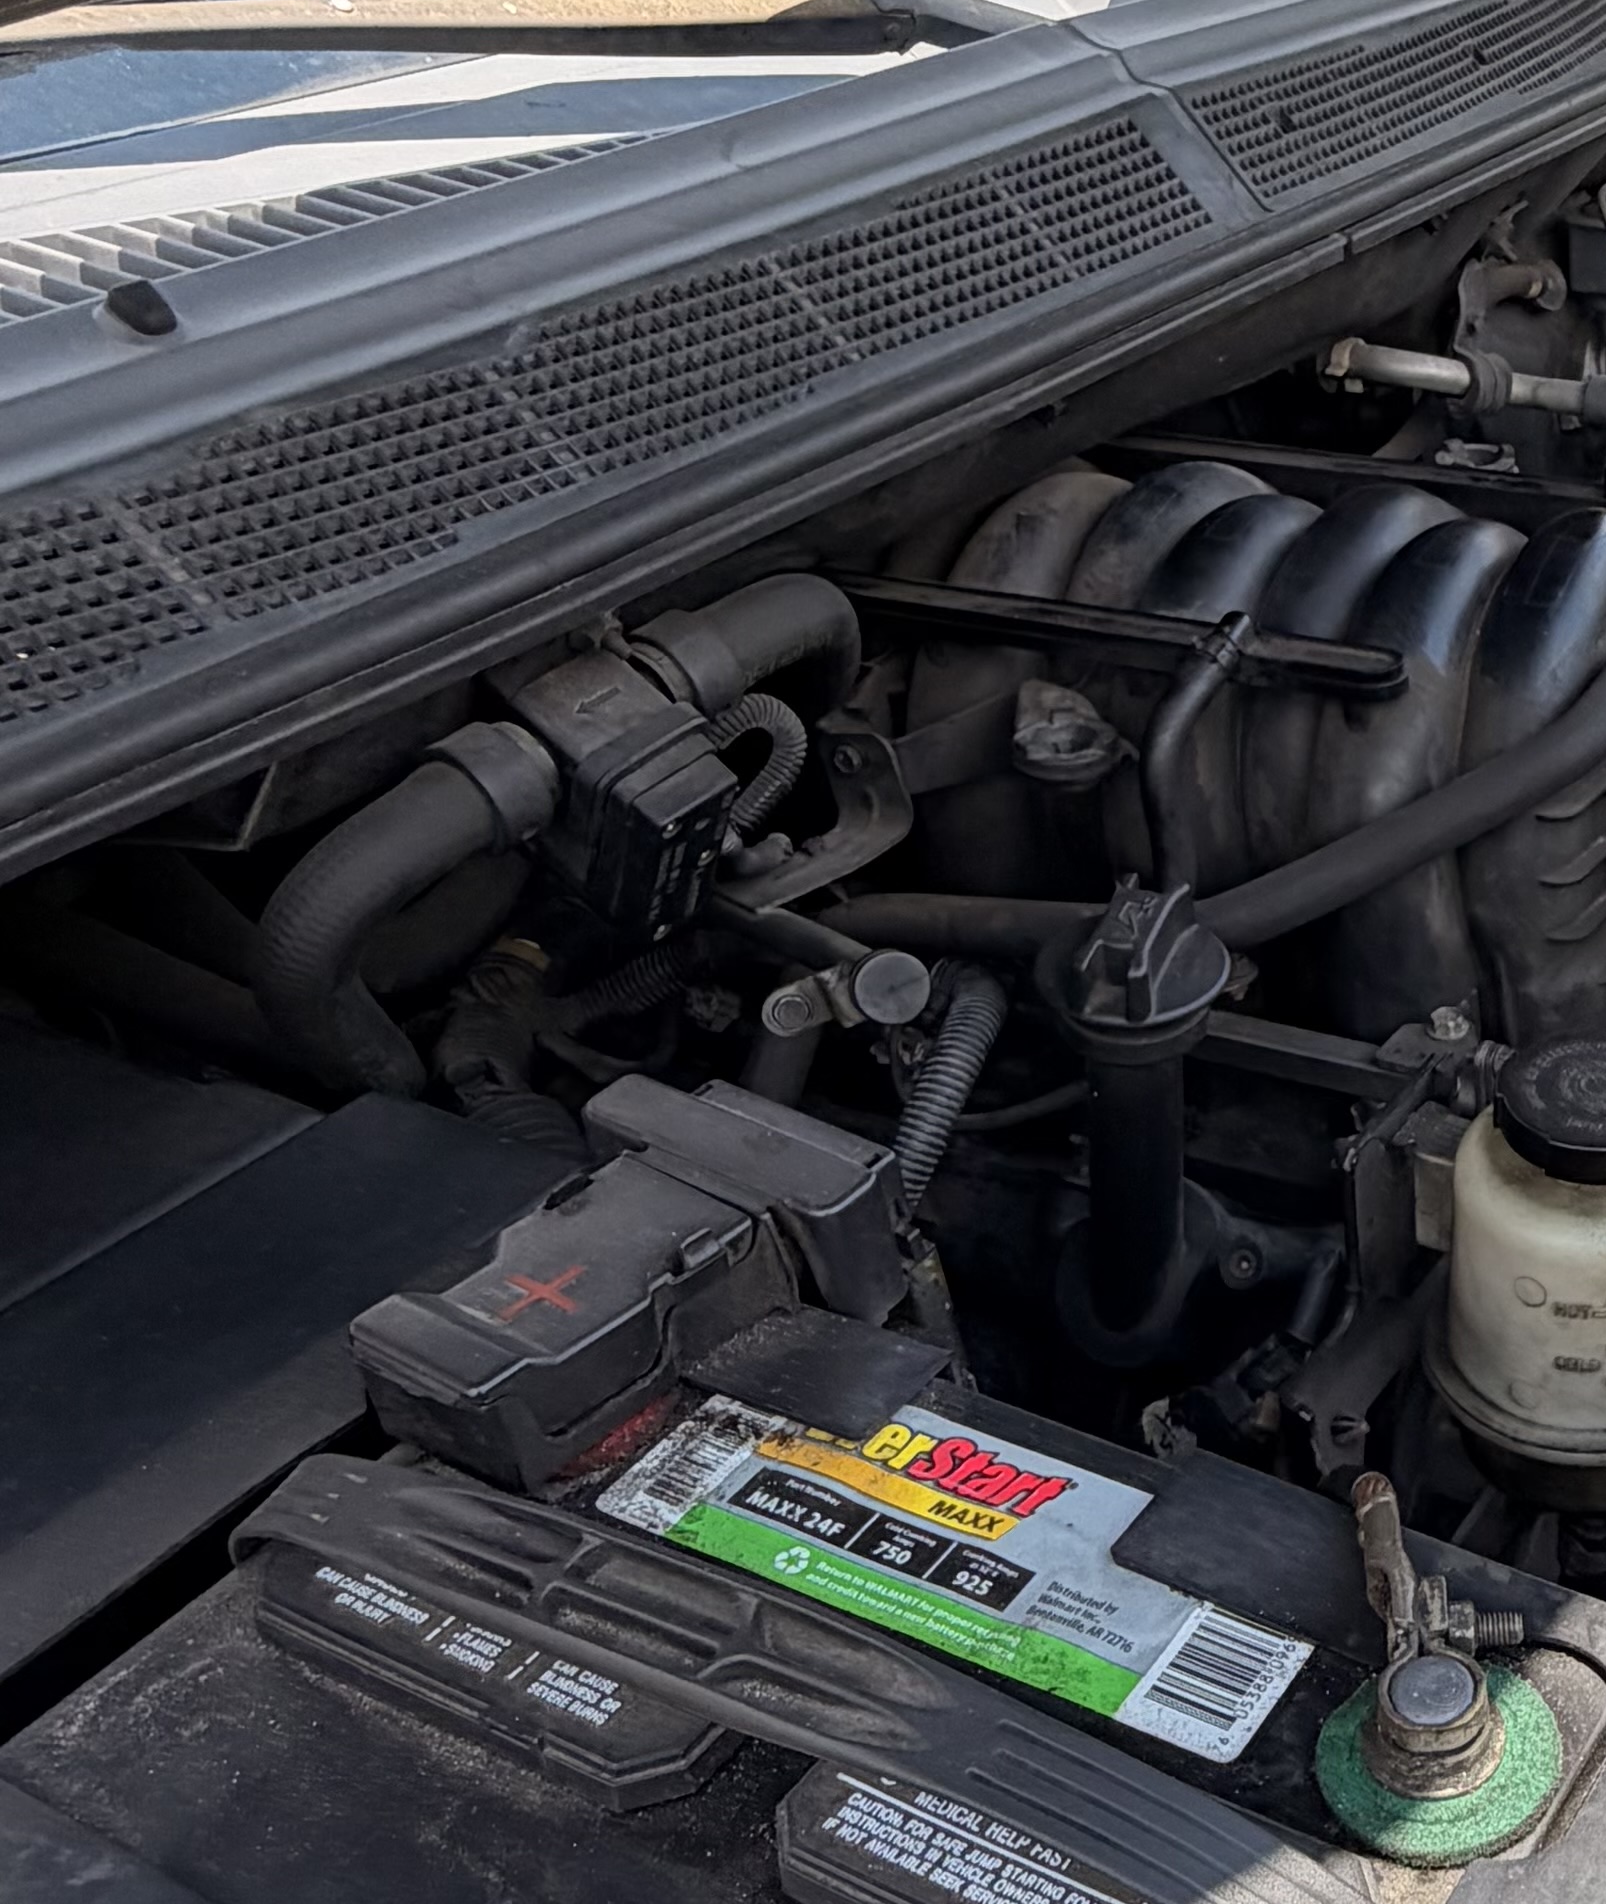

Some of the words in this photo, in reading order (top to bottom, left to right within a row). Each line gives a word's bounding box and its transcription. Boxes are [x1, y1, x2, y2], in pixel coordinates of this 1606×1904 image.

[804, 1424, 1072, 1519] erStart
[745, 1489, 808, 1522] MAXX
[803, 1511, 846, 1537] 24F
[928, 1500, 1004, 1533] MAXX
[872, 1540, 912, 1565] 750
[315, 1566, 341, 1584] CAN
[338, 1576, 377, 1601] CAUSE
[370, 1591, 430, 1626] BLINDNESS
[816, 1561, 852, 1582] Return
[852, 1576, 865, 1587] to
[865, 1580, 921, 1608] WALMART
[917, 1595, 935, 1614] for
[933, 1608, 973, 1632] proper
[952, 1570, 994, 1596] 925
[1038, 1592, 1083, 1616] Walmart
[1047, 1579, 1107, 1611] Distributed
[1103, 1601, 1120, 1616] by
[805, 1572, 827, 1587] and
[857, 1593, 896, 1614] toward
[903, 1610, 927, 1625] new
[925, 1617, 967, 1645] battery
[1085, 1625, 1106, 1639] AR
[1101, 1630, 1136, 1654] 72716
[538, 1669, 602, 1704] BLINDNESS
[599, 1697, 622, 1714] OR
[552, 1659, 580, 1678] CAN
[578, 1670, 620, 1696] CAUSE
[526, 1681, 574, 1710] SEVERE
[566, 1700, 609, 1726] BURNS
[913, 1791, 985, 1832] MEDICAL
[821, 1816, 841, 1831] IF
[835, 1824, 869, 1846] NOT
[863, 1838, 933, 1877] AVAILABLE
[928, 1867, 967, 1894] SEEK
[837, 1805, 927, 1857] INSTRUCTIONS
[924, 1847, 944, 1862] IN
[941, 1853, 996, 1888] VEHICLE
[903, 1818, 935, 1841] FOR
[931, 1833, 968, 1857] SAFE
[965, 1849, 1004, 1871] JUMP
[1001, 1864, 1067, 1901] STARTING
